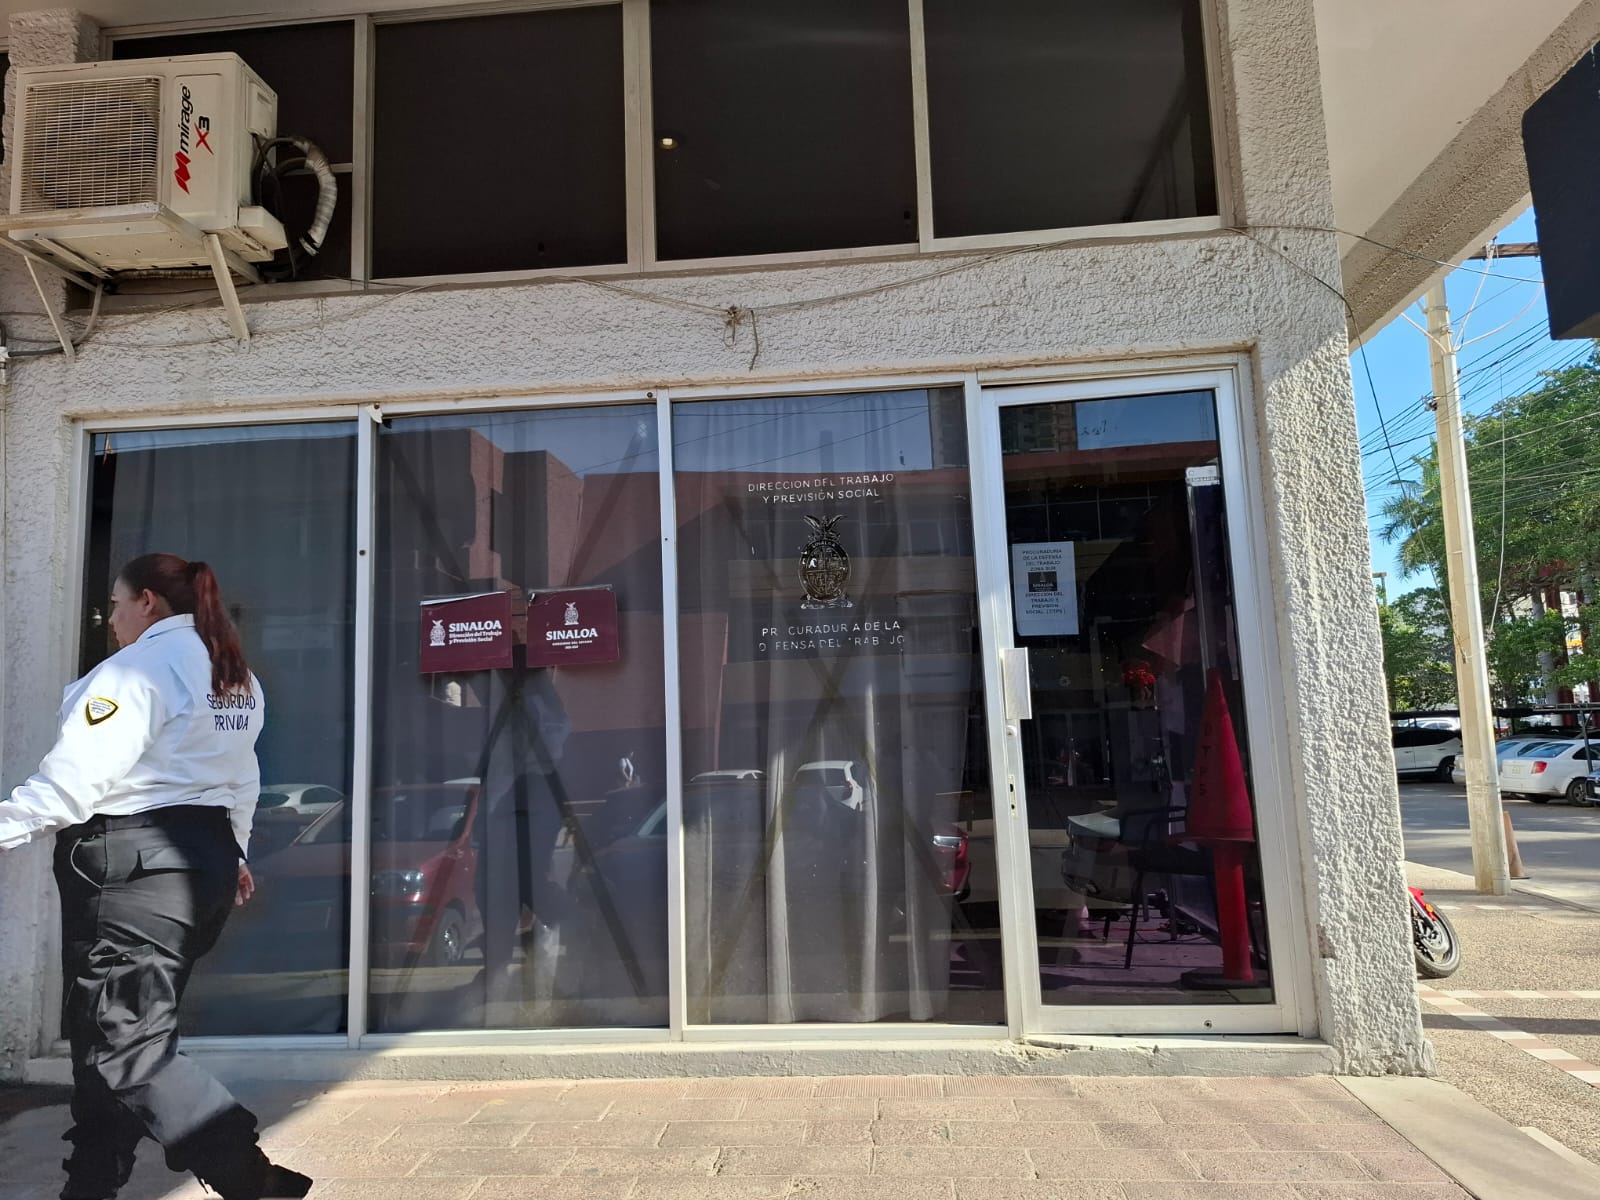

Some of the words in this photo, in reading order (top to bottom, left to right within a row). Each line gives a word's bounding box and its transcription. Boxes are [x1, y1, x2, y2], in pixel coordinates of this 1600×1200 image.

[178, 85, 194, 154] mirage
[194, 116, 214, 155] X3
[748, 480, 810, 492] DIRECCION
[839, 473, 894, 486] TRABAJO
[762, 495, 770, 504] Y
[838, 488, 880, 499] SOCIAL
[448, 619, 502, 633] SINALOA
[864, 621, 880, 631] DE
[884, 620, 901, 631] LA
[545, 627, 598, 641] SINALOA
[206, 693, 256, 710] SEGURIDAD
